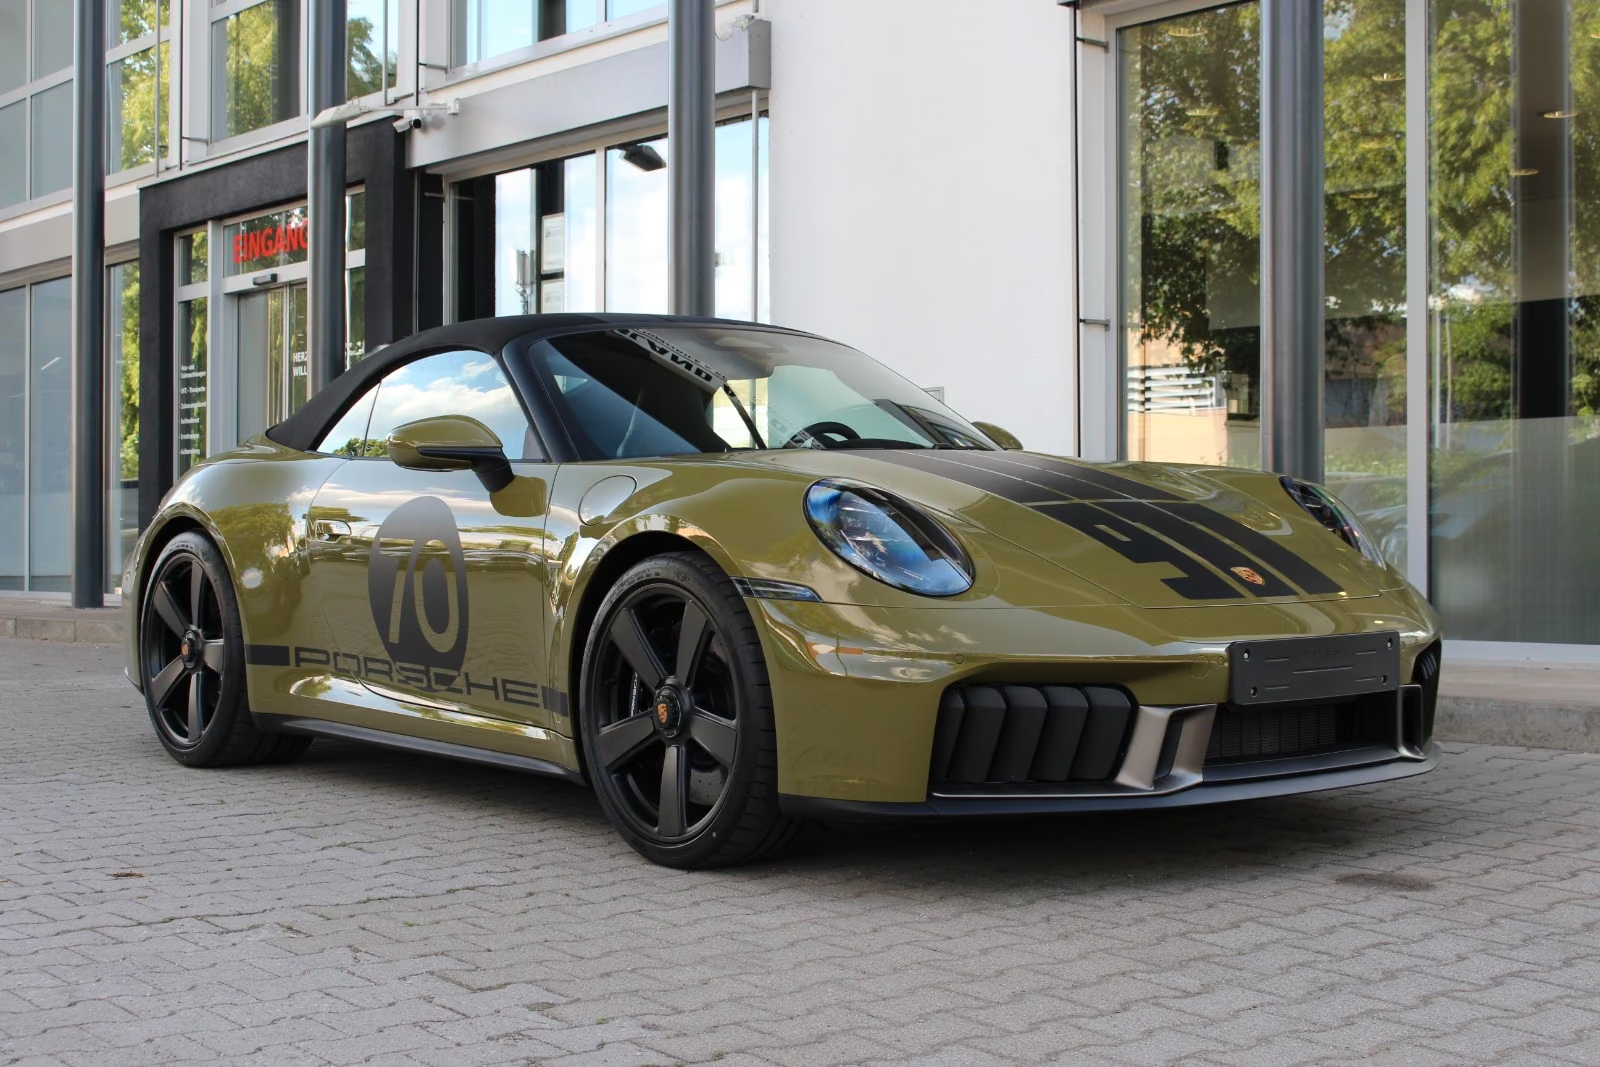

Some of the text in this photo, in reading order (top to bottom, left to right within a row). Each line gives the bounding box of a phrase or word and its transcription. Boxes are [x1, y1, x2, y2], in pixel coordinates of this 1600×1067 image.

[232, 217, 308, 264] EINGANG
[379, 538, 459, 653] 70
[295, 647, 541, 707] PORSCHE
